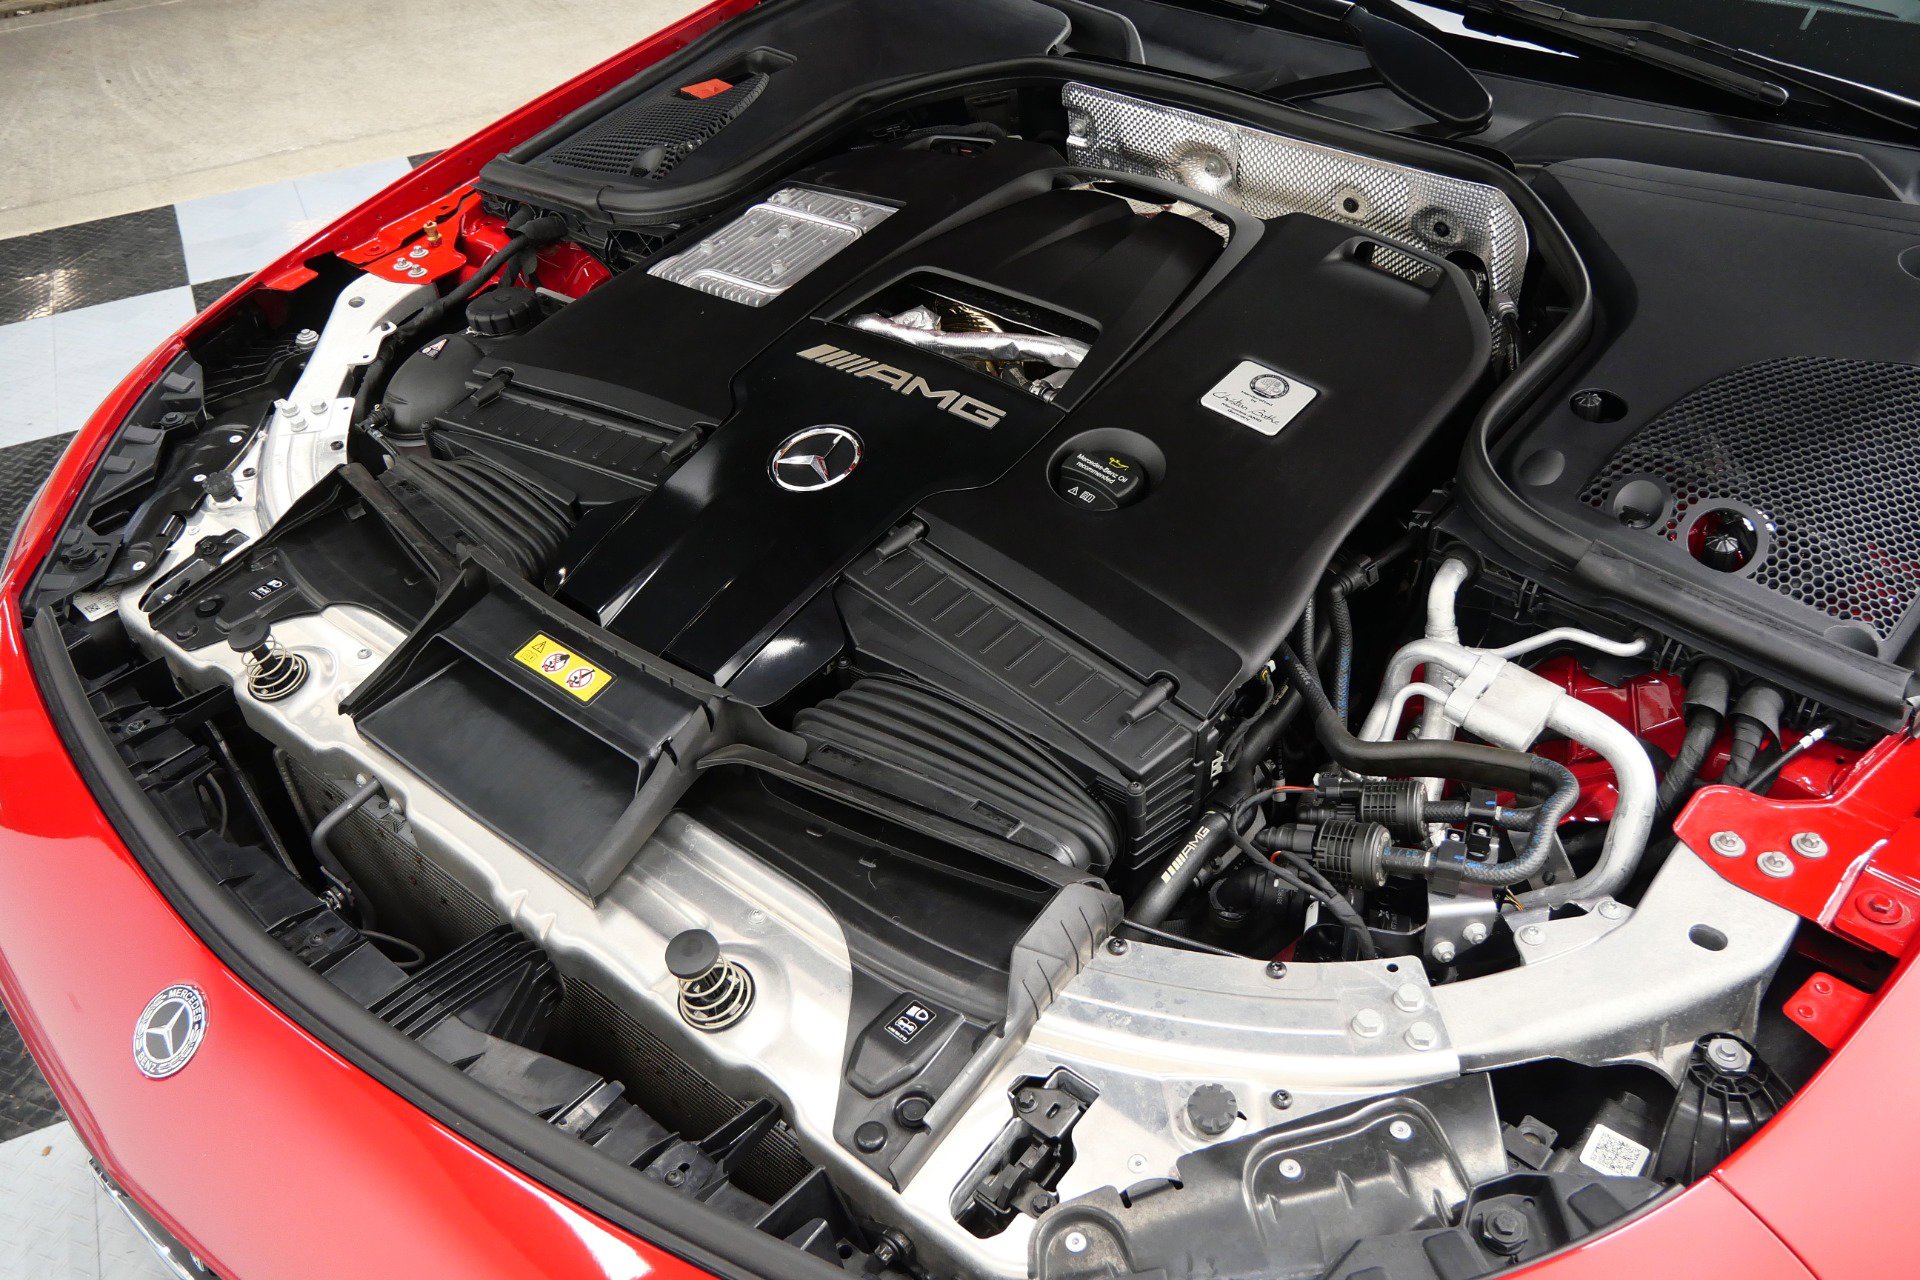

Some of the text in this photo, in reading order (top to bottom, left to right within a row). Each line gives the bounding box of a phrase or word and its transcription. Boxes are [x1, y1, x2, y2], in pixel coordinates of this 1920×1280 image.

[854, 363, 1007, 430] AMG
[1075, 461, 1116, 485] recommended
[168, 988, 203, 1021] MERCEDES
[137, 1050, 157, 1073] BENZ
